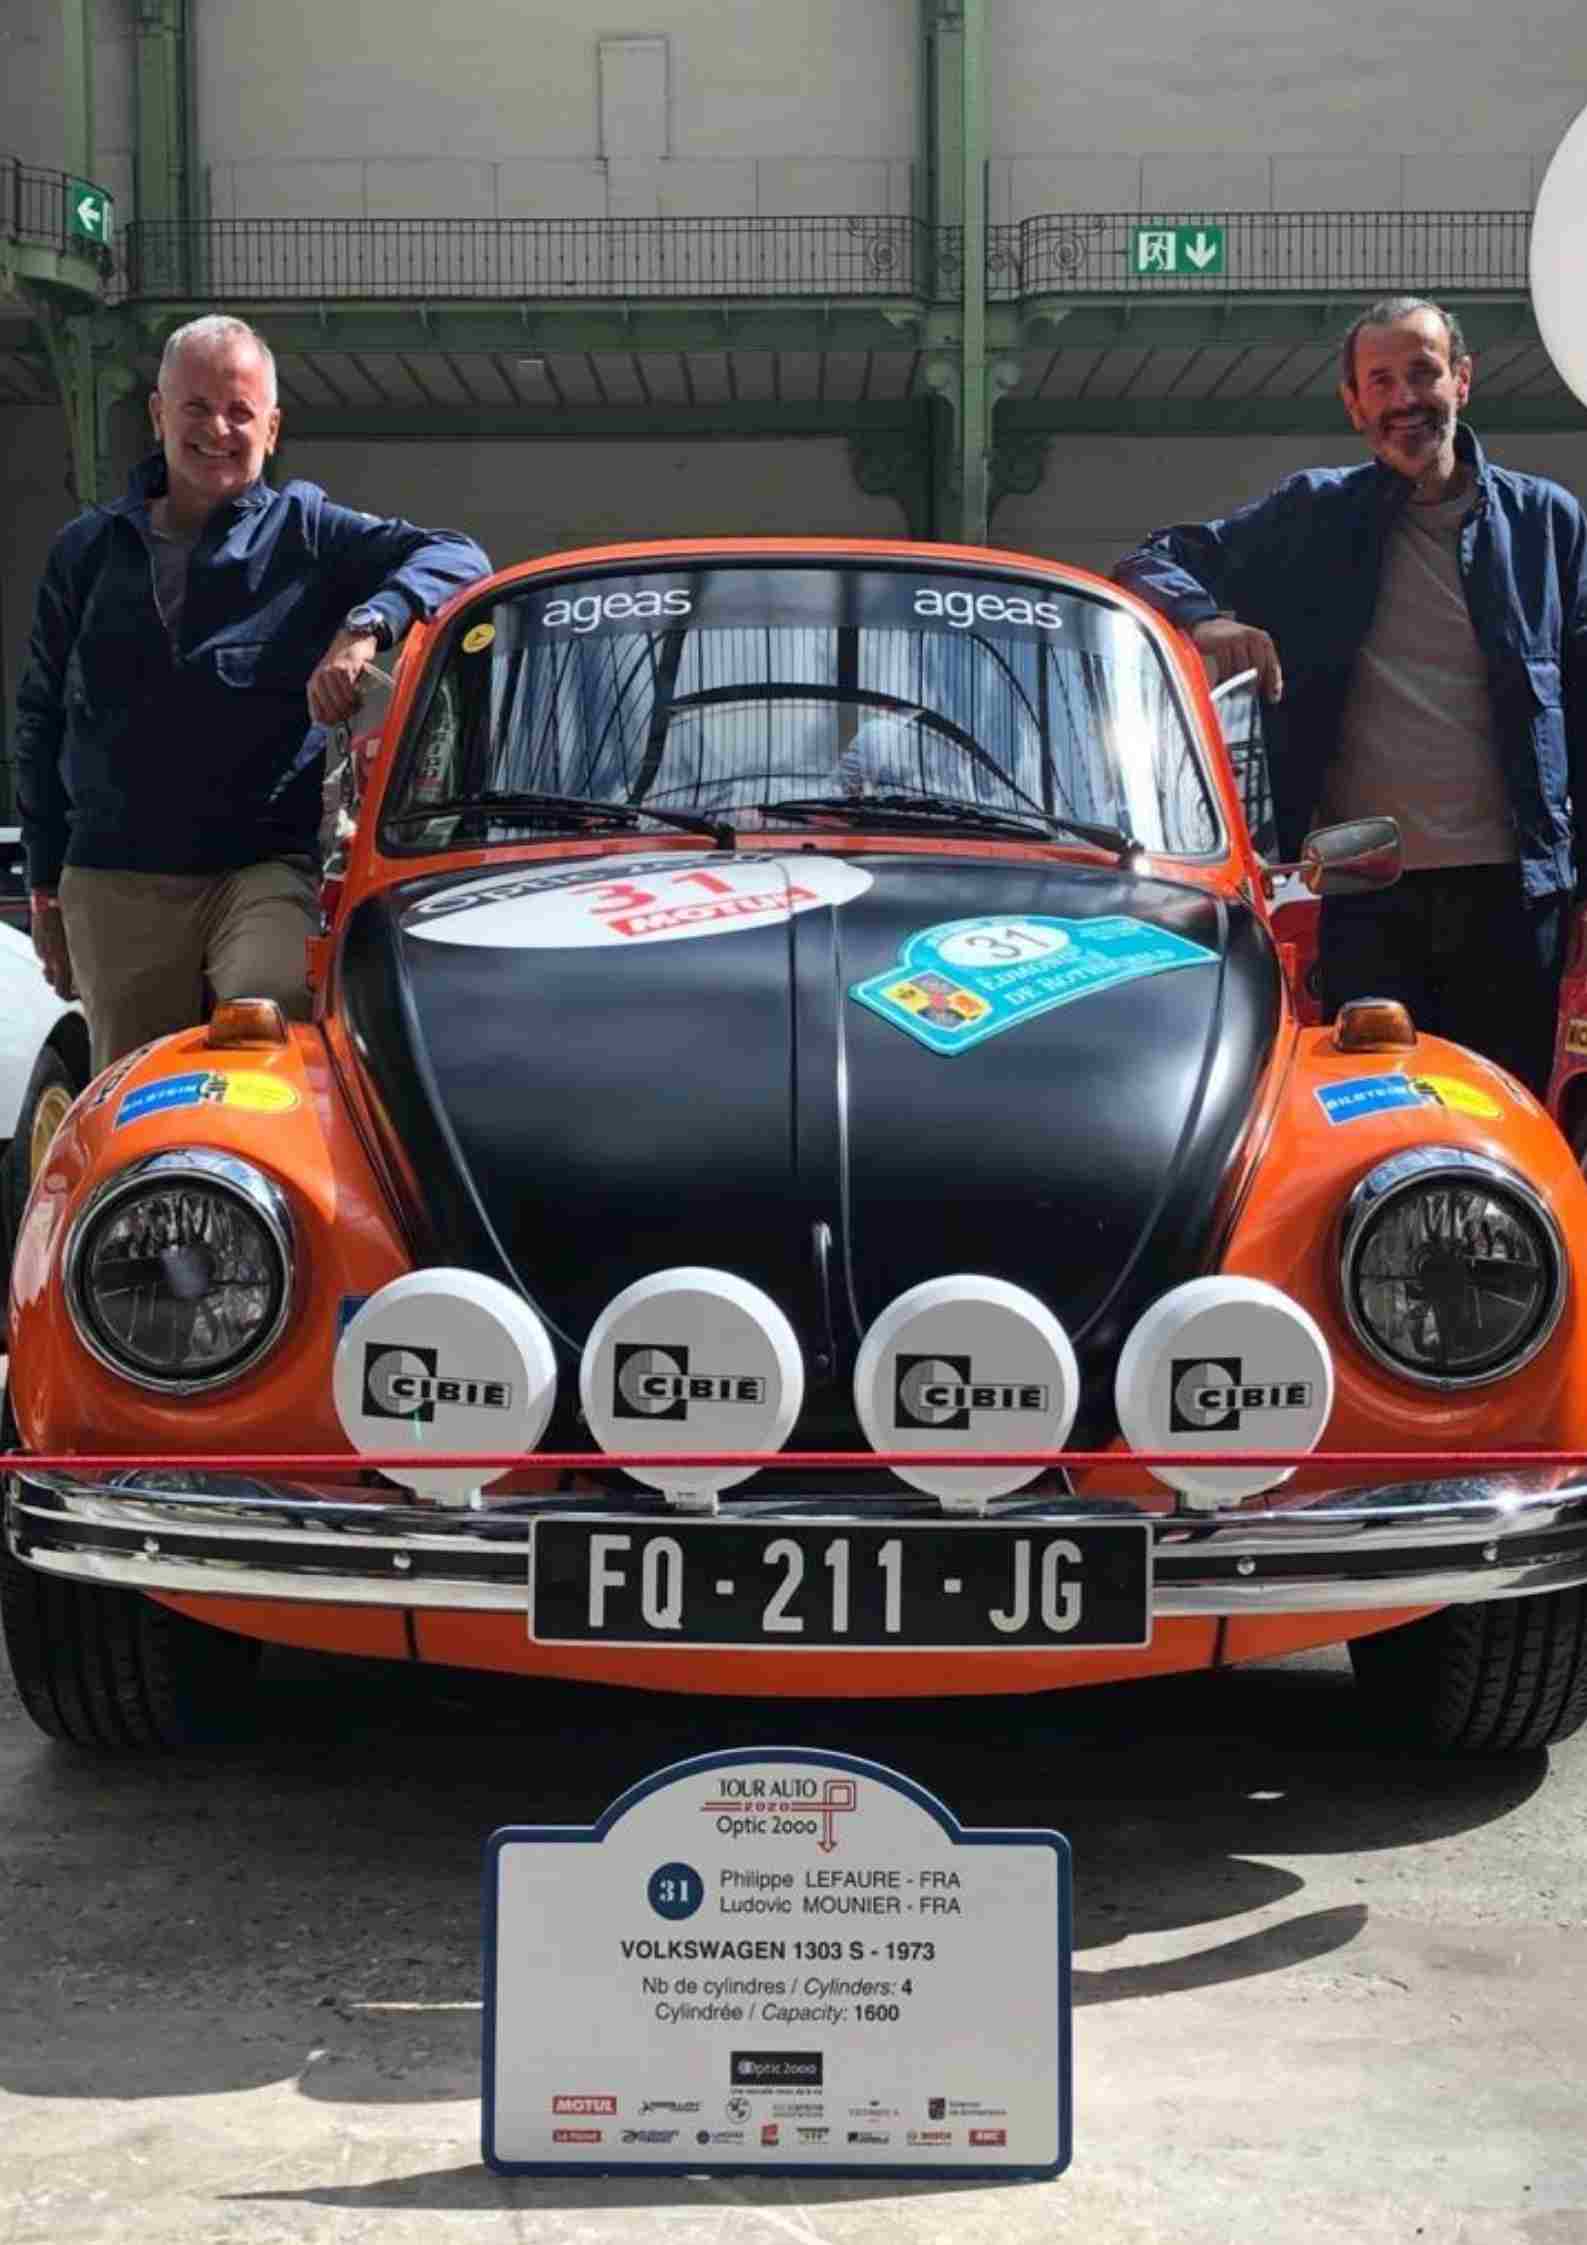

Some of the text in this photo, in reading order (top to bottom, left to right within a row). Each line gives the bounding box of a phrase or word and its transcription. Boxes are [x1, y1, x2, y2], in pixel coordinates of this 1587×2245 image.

[543, 589, 692, 632] ageas
[914, 589, 1063, 629] ageas
[572, 872, 736, 915] 31
[966, 928, 1050, 960] 31
[588, 1534, 684, 1630] FQ
[762, 1538, 904, 1633] 211
[988, 1539, 1084, 1633] JG
[719, 1779, 817, 1798] TOUR AUTO
[744, 1801, 791, 1812] 2020
[716, 1815, 767, 1838] Optic
[659, 1879, 689, 1902] 31
[720, 1869, 795, 1892] Philippe
[805, 1870, 901, 1889] LEFAURE
[919, 1870, 961, 1889] FRA
[720, 1895, 792, 1914] Ludovic
[803, 1895, 901, 1915] MOUNIER
[919, 1896, 961, 1915] FRA
[620, 1940, 786, 1960] VOLKSWAGEN
[793, 1941, 843, 1960] 1303
[849, 1940, 864, 1960] S
[885, 1941, 936, 1960] 1973
[642, 1977, 913, 1999] Nb de cylindres / Cylinders: 4
[655, 2001, 900, 2025] Cylindrée / Capacity: 1600
[555, 2098, 614, 2112] MOTUL
